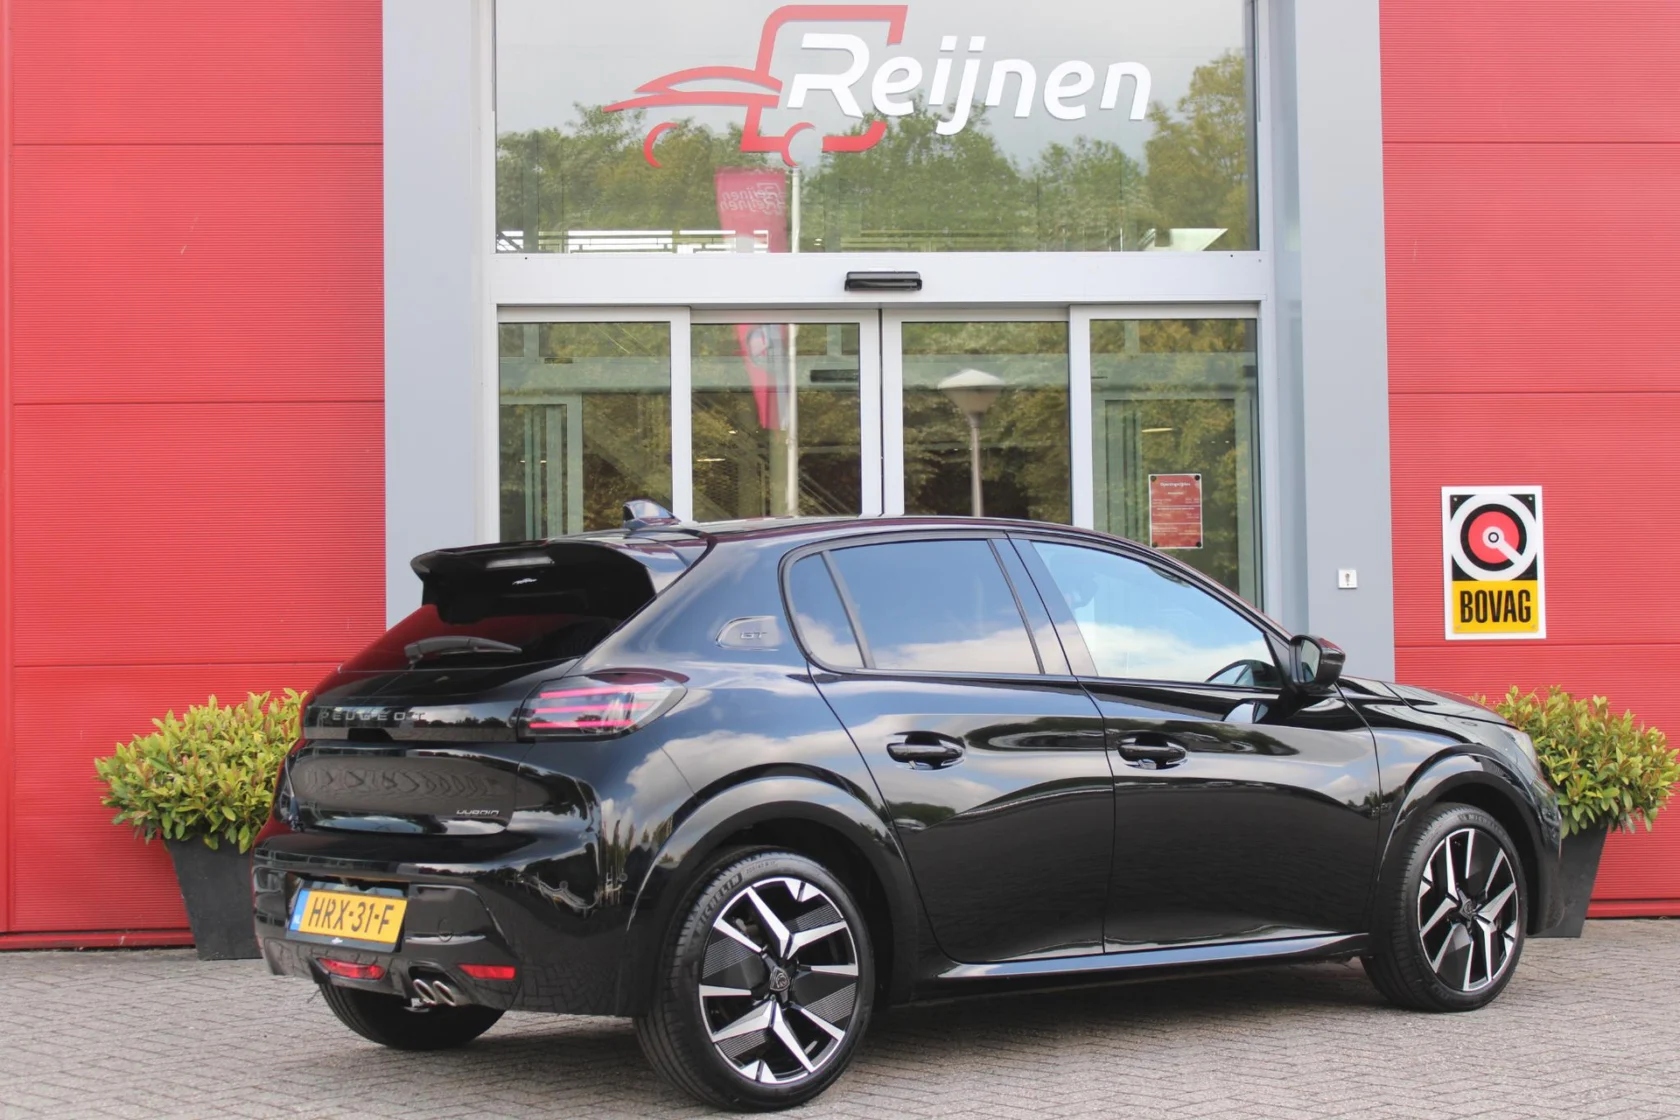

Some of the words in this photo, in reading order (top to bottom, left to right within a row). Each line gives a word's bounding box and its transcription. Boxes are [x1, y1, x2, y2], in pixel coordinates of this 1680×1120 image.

[786, 33, 1152, 135] Reijnen
[1459, 589, 1532, 624] BOVAG
[741, 631, 768, 639] GT
[320, 710, 426, 721] PEUGEOT
[308, 896, 395, 935] HRX-31-F
